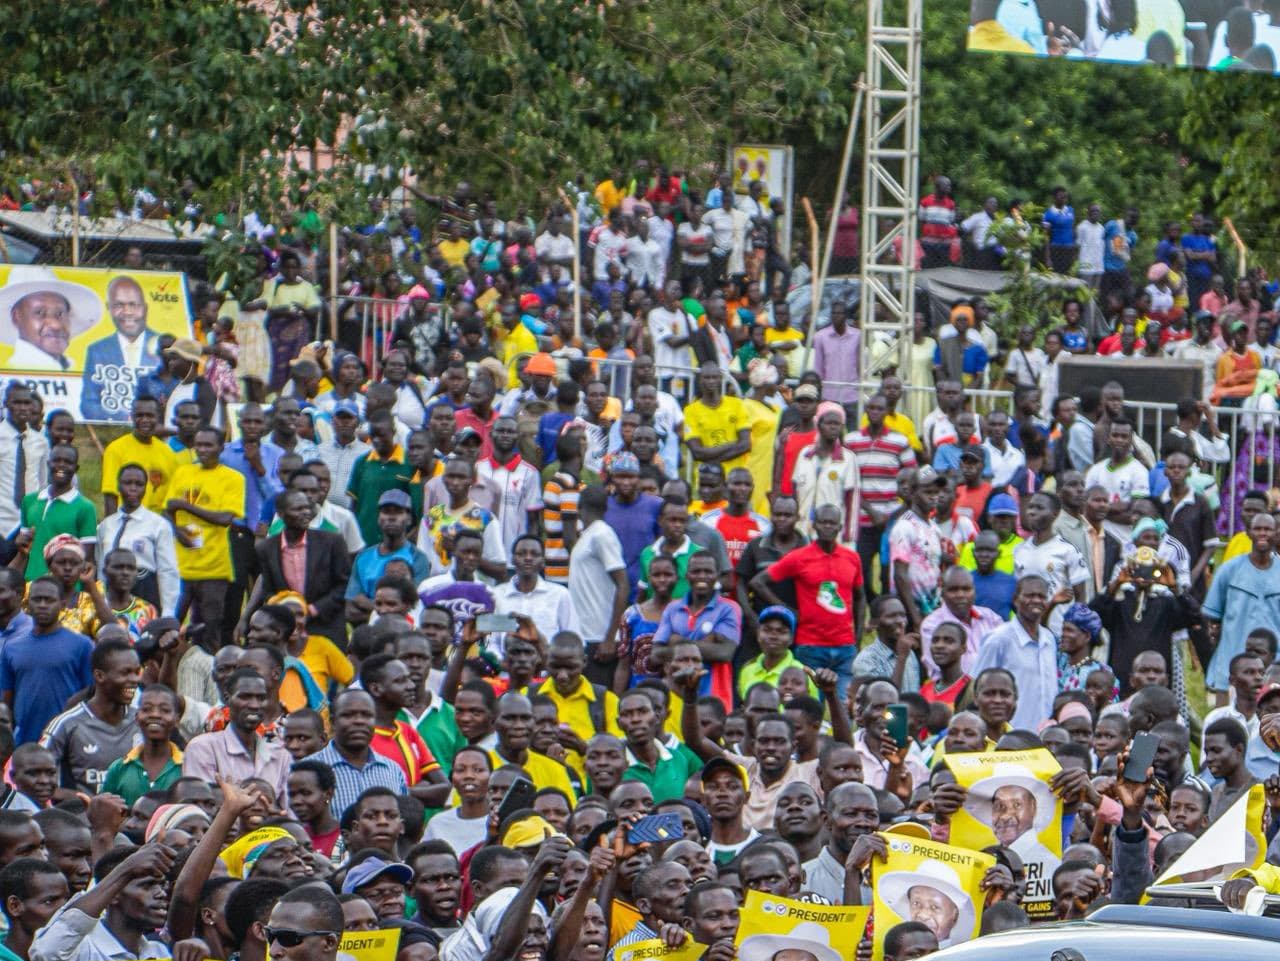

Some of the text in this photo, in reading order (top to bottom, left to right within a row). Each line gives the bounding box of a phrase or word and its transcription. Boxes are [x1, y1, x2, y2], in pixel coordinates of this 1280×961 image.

[150, 292, 179, 303] Vote
[101, 382, 137, 398] JO
[912, 845, 972, 867] PRESIDENT
[787, 907, 846, 923] PRESIDENT
[1028, 901, 1052, 913] GAINS
